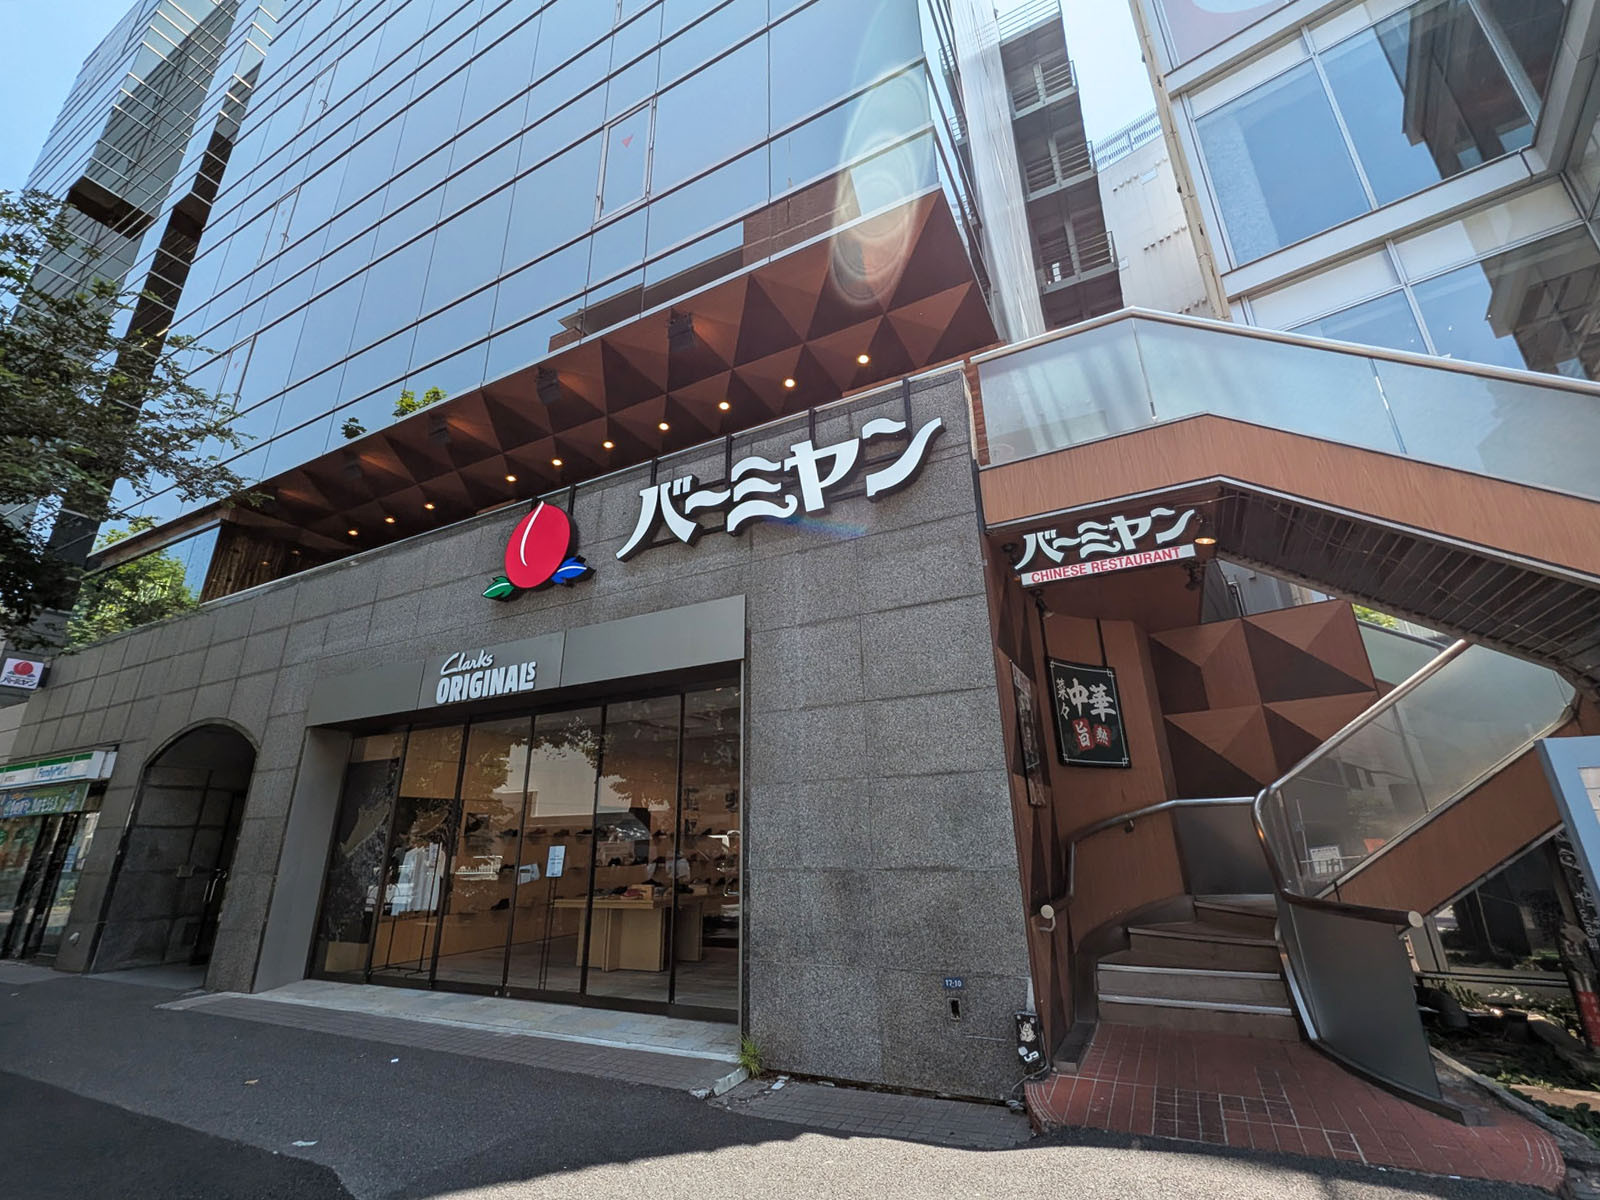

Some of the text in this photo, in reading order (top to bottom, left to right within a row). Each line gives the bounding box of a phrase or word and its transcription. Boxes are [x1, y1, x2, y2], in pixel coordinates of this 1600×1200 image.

[615, 416, 944, 560] バーミヤン
[1014, 507, 1196, 570] バーミヤン
[1031, 546, 1181, 584] CHINESE RESTAURANT
[0, 676, 37, 687] バーミヤン
[440, 649, 494, 676] Clarks
[1066, 677, 1117, 723] 中華
